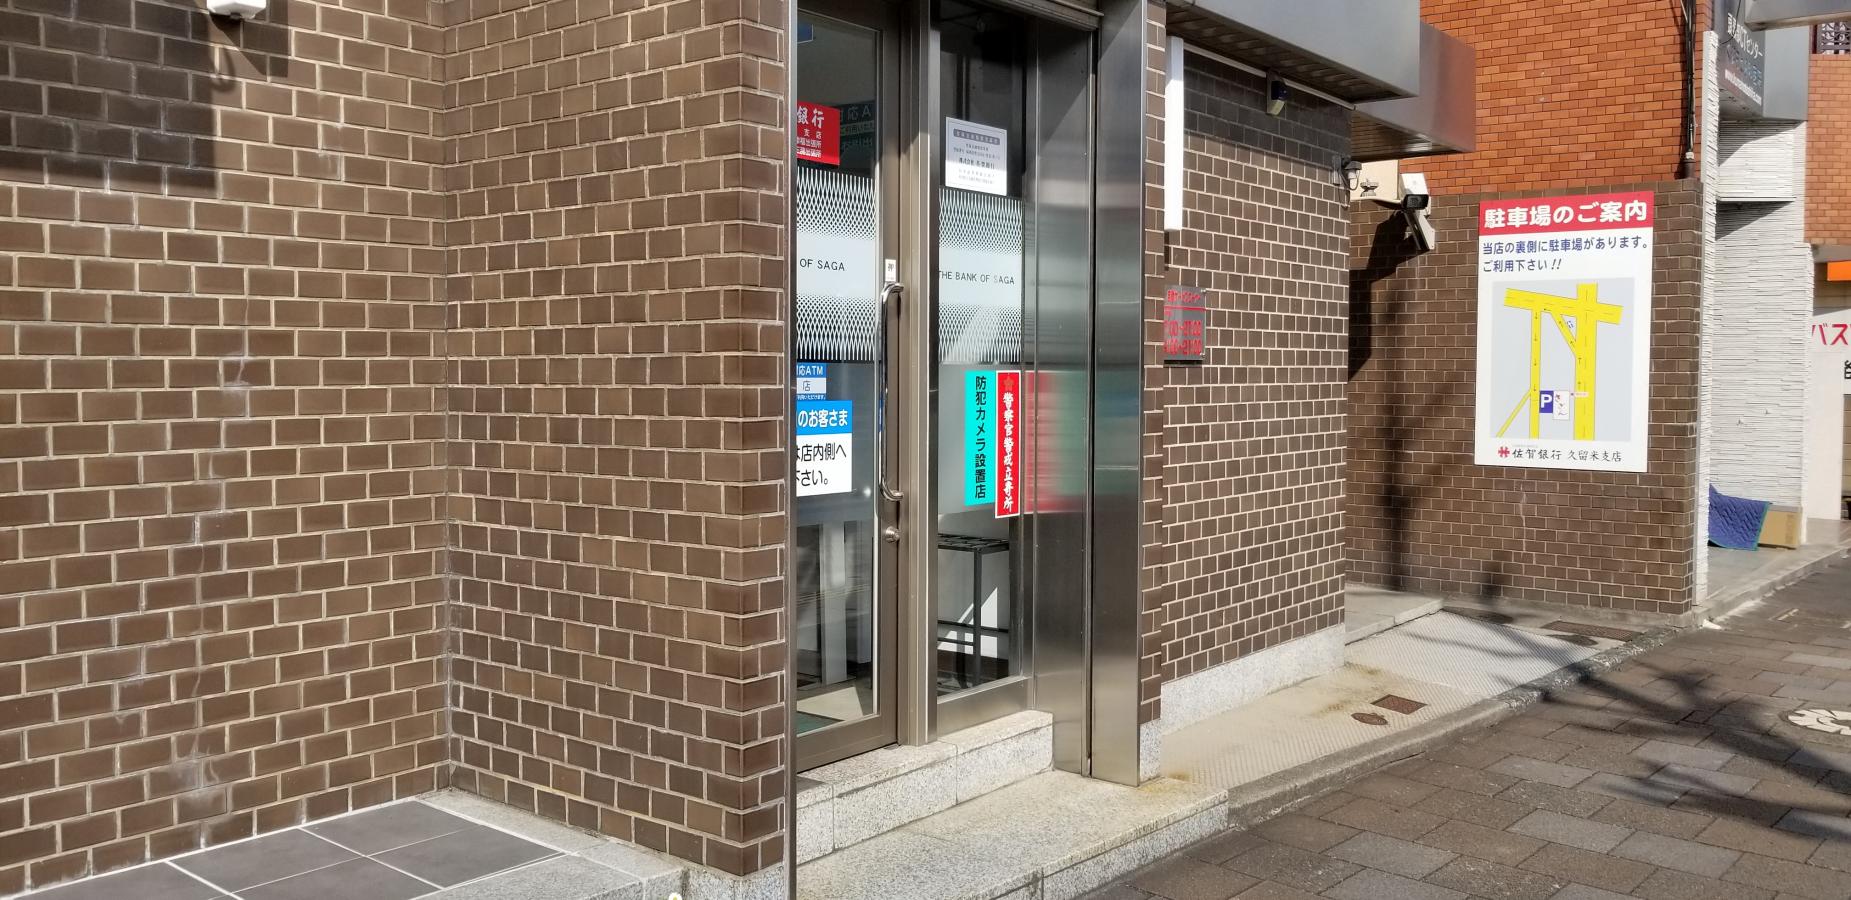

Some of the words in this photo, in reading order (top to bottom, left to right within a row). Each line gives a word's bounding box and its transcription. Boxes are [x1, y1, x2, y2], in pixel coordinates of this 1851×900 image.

[1484, 199, 1647, 229] 駐車場のご案内
[1483, 235, 1648, 255] 当店の裏側に駐車場があります。
[799, 258, 814, 268] OF
[817, 259, 845, 272] SAGA
[955, 271, 977, 282] BANK
[980, 274, 990, 283] OF
[993, 275, 1015, 285] SAGA
[1811, 323, 1851, 345] バス
[796, 364, 824, 377] 応ATM
[1540, 393, 1553, 409] P
[798, 408, 849, 428] のお客さま
[975, 375, 988, 499] 防犯カメラ設置店
[1512, 448, 1562, 461] 佐賀銀行
[1567, 449, 1622, 463] 久留米支店
